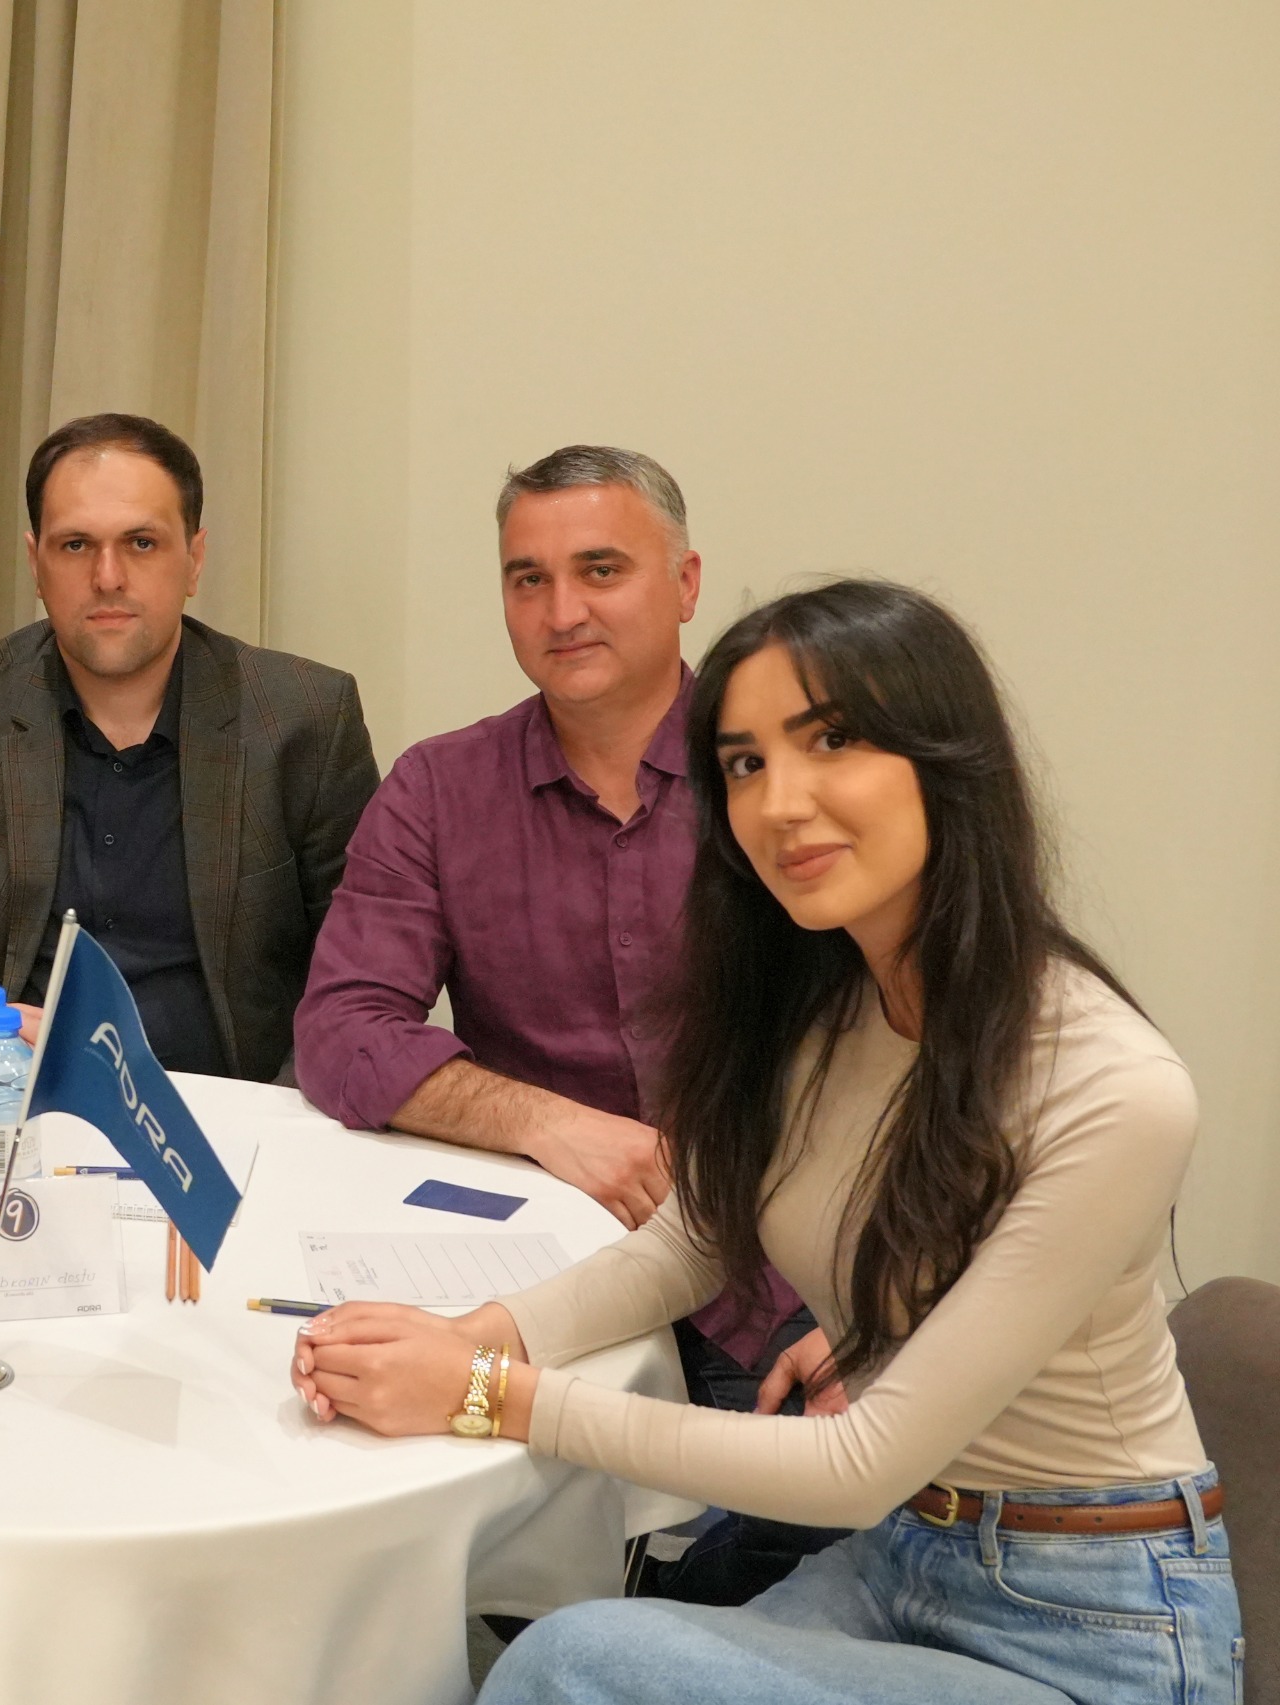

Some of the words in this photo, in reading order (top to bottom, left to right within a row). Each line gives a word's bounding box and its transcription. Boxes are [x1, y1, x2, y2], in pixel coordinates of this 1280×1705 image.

[90, 1022, 193, 1193] ADRA
[6, 1200, 23, 1233] 9
[77, 1304, 102, 1312] ADRA
